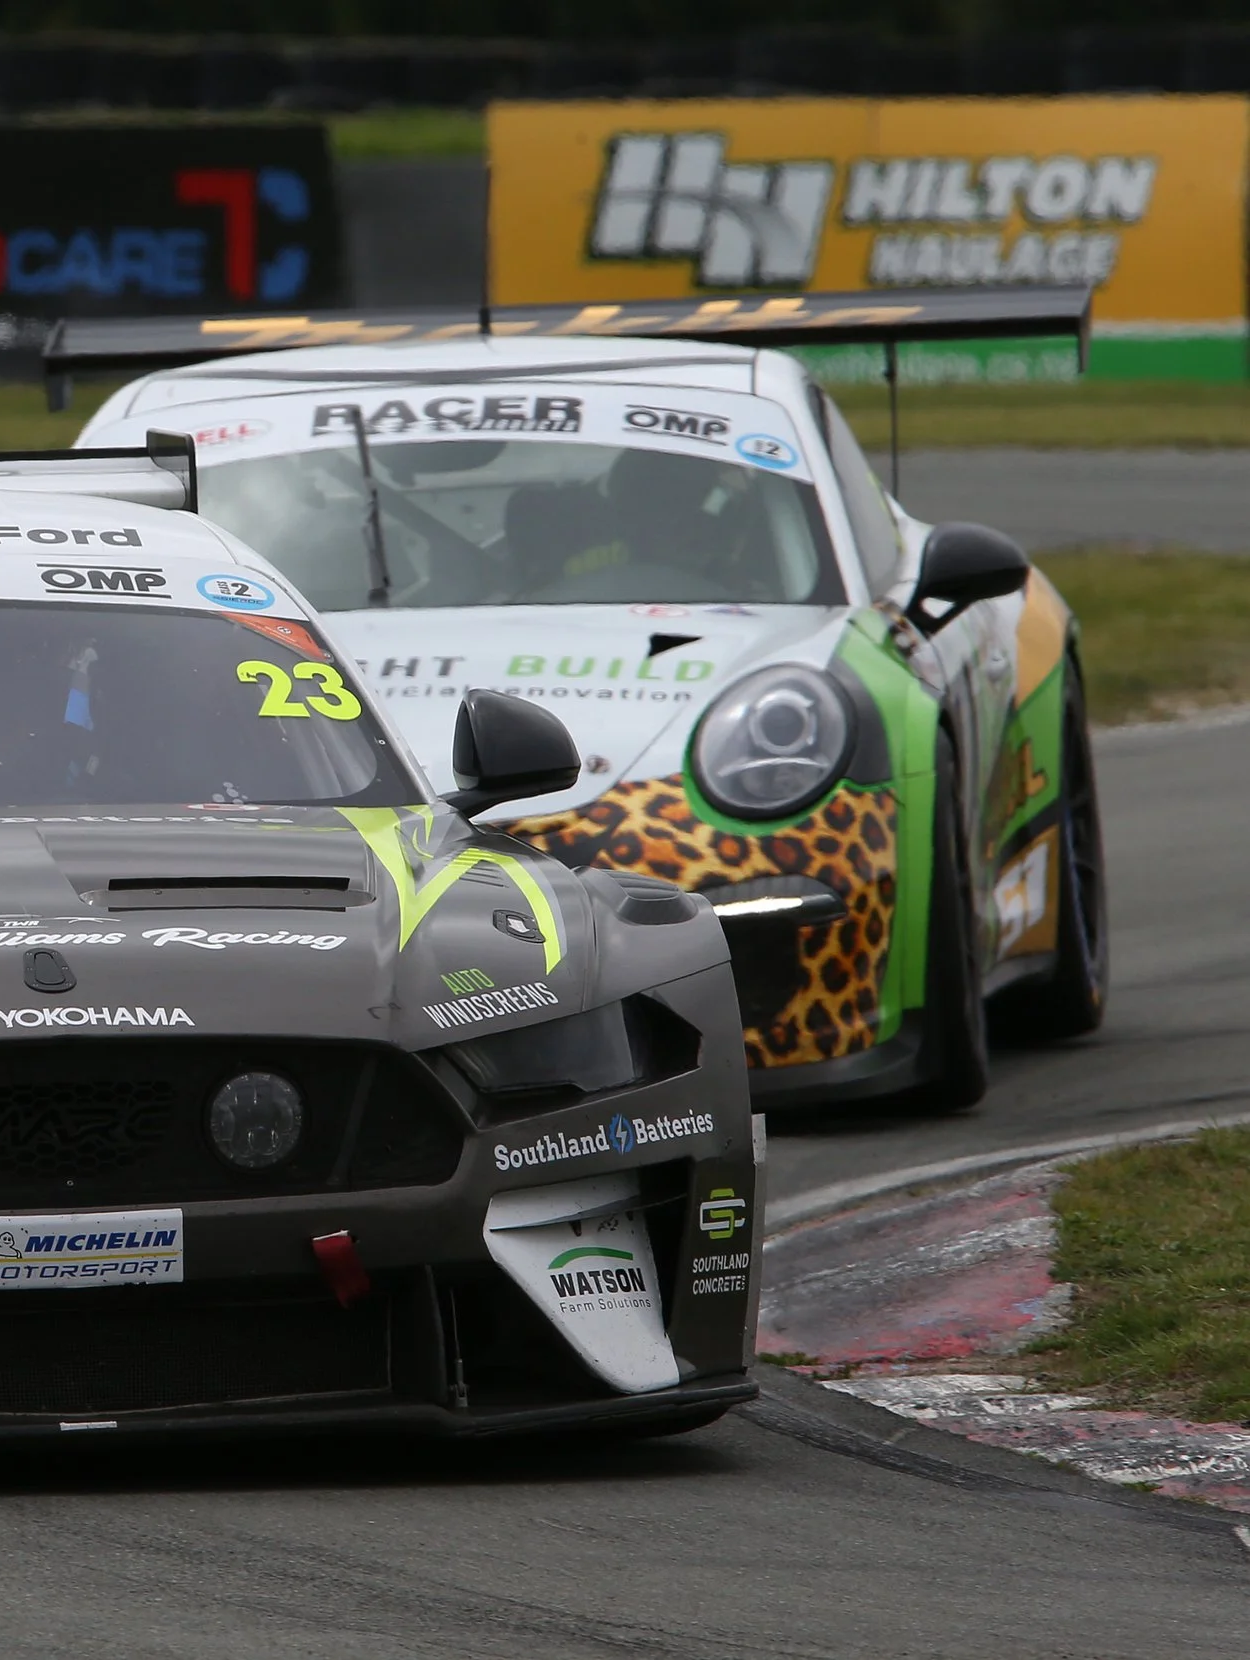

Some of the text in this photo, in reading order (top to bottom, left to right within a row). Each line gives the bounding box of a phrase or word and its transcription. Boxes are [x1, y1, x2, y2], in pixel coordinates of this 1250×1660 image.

[845, 157, 1154, 224] HILTON
[868, 231, 1119, 285] HAULAGE
[312, 395, 585, 434] RACER
[624, 409, 729, 437] OMP
[195, 423, 252, 444] ELL
[41, 568, 167, 592] OMP
[231, 582, 252, 597] 2
[354, 654, 716, 682] HT BUILD
[236, 660, 362, 720] 23
[3, 920, 40, 928] TWR
[142, 927, 347, 950] Racing
[441, 968, 495, 995] AUTO
[422, 982, 559, 1029] WINDSCREENS
[494, 1109, 714, 1171] Southland Batteries
[25, 1230, 177, 1252] MICHELIN
[692, 1252, 750, 1275] SOUTHLAND
[550, 1267, 647, 1298] WATSON
[692, 1275, 741, 1296] CONCRETE
[560, 1296, 652, 1314] Farm Solutions
